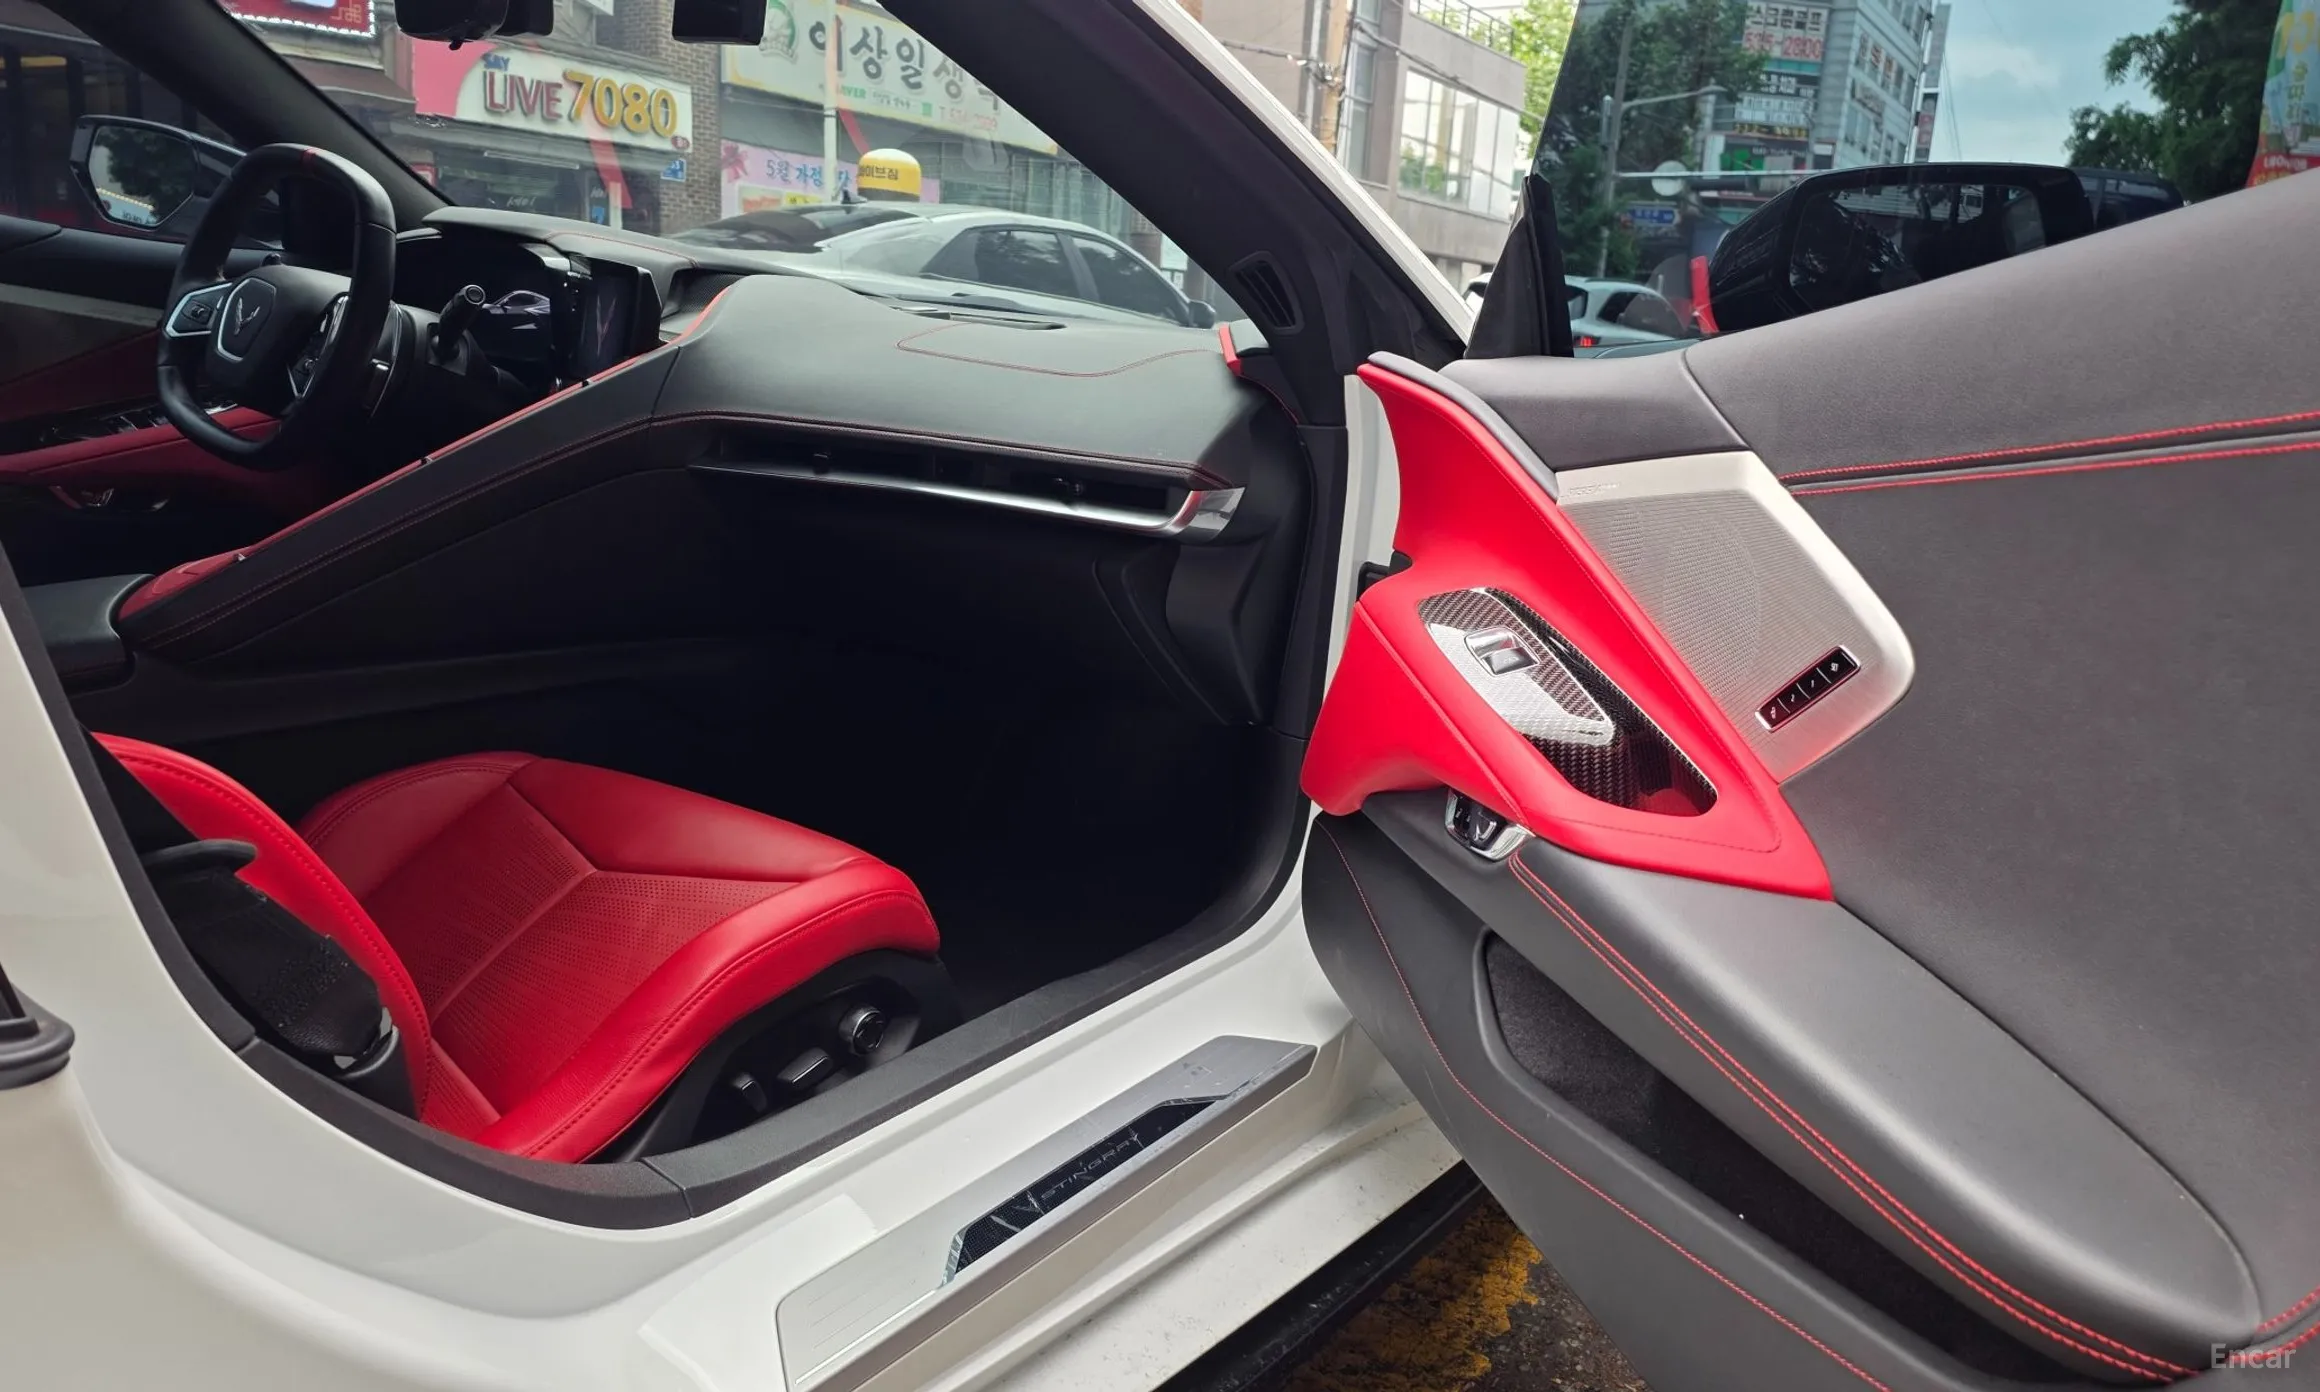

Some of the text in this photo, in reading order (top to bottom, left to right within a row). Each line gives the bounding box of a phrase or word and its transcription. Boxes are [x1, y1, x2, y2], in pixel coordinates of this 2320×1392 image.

[484, 68, 678, 139] LIVE 7080
[1041, 1133, 1141, 1200] STINGRAY
